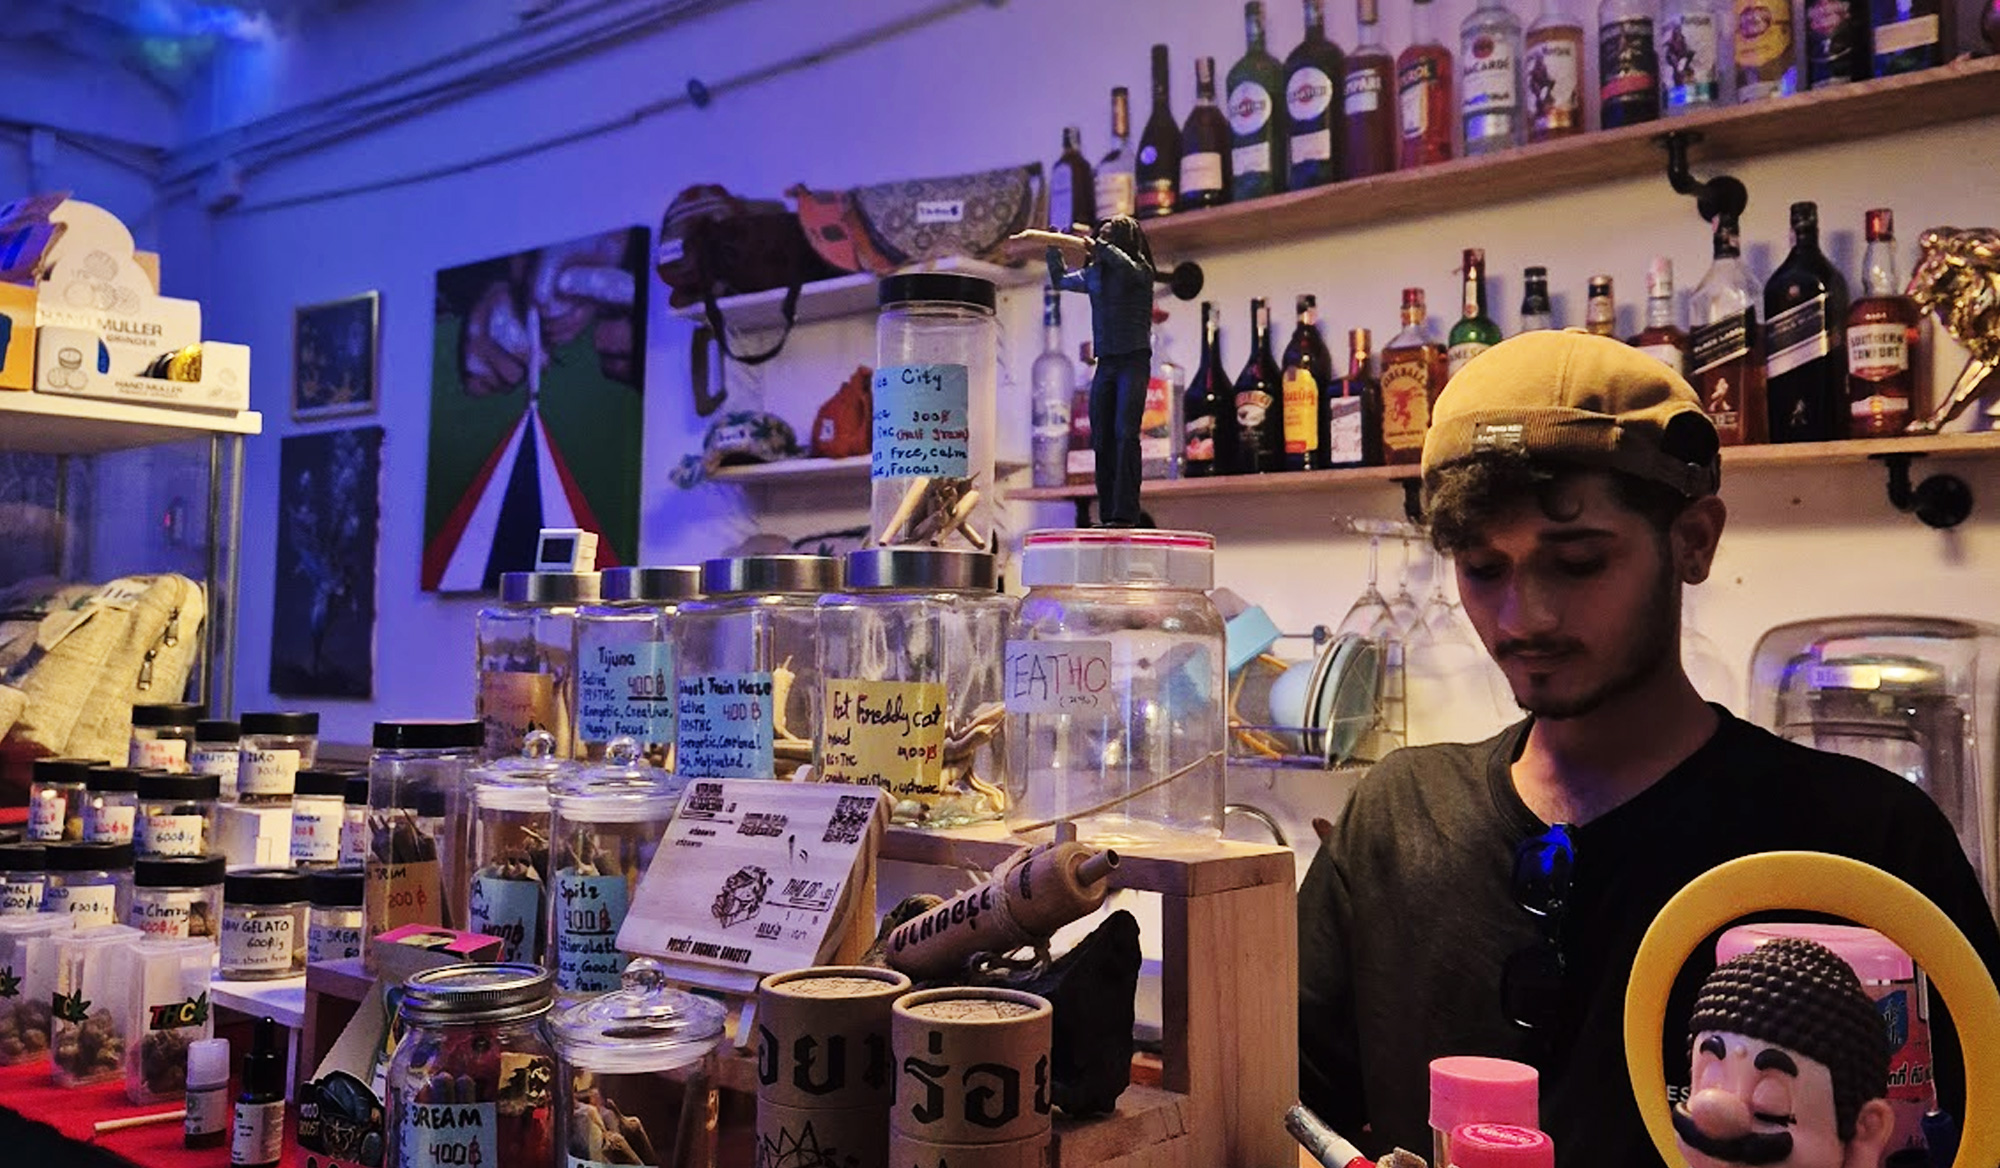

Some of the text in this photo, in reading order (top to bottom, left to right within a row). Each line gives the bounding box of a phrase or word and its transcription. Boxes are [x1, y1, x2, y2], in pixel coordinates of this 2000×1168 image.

[100, 317, 164, 337] MULLER
[901, 368, 942, 391] City
[857, 692, 911, 737] Freddy
[560, 879, 601, 906] Spitz
[146, 903, 190, 923] Cherry
[241, 920, 289, 934] GELATO
[581, 959, 620, 975] Good
[149, 1002, 198, 1024] THC
[411, 1104, 484, 1130] DREAM
